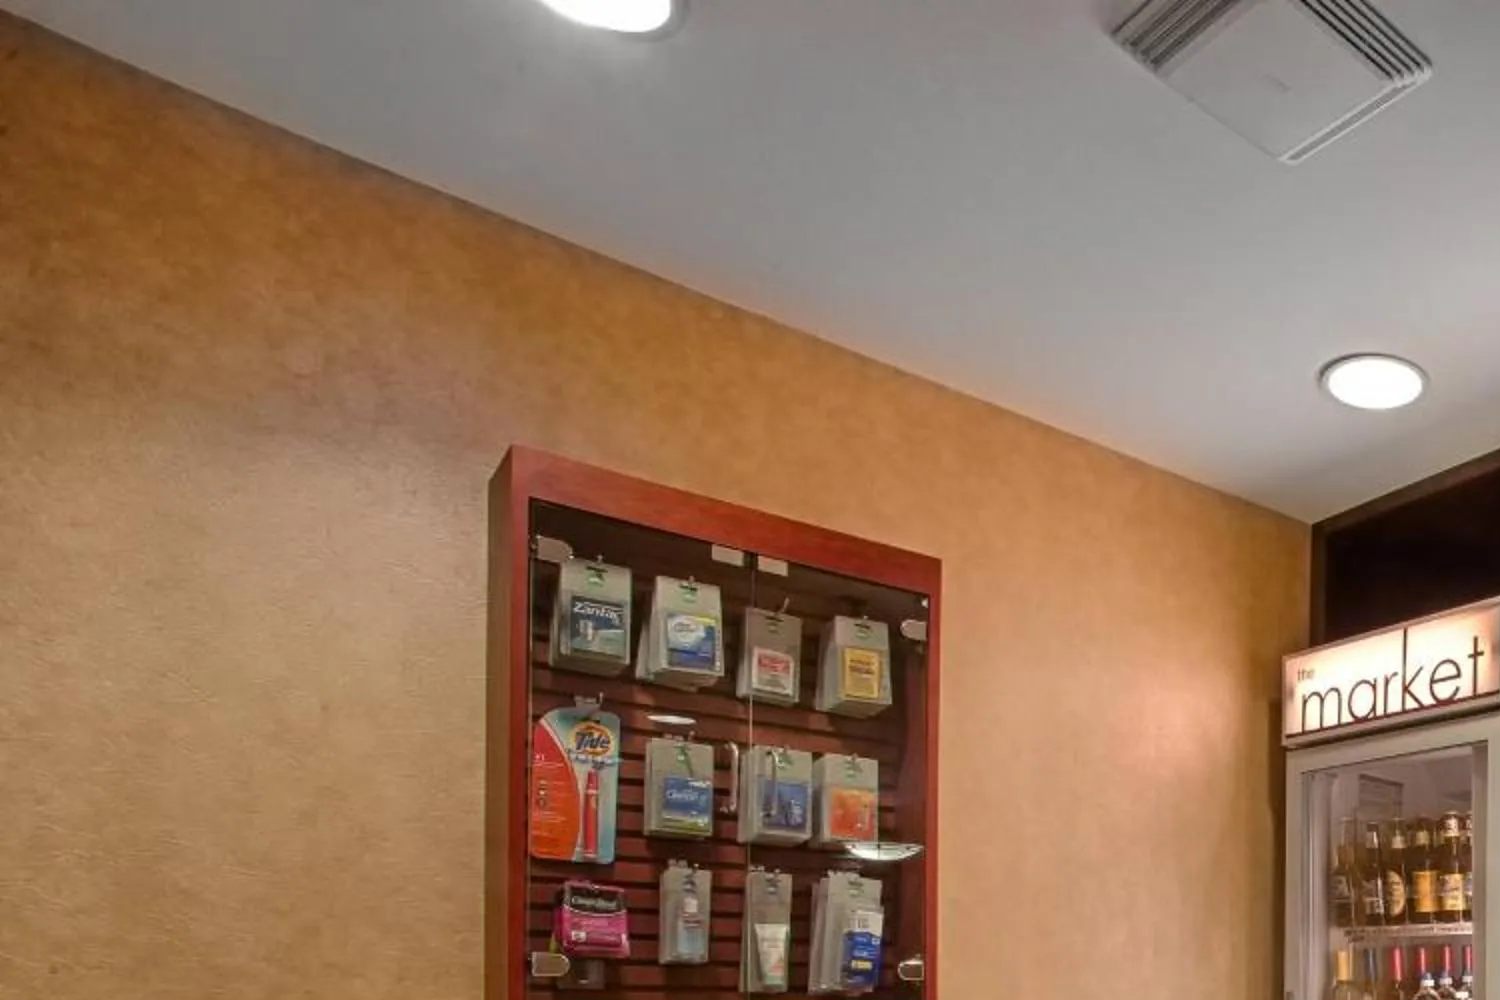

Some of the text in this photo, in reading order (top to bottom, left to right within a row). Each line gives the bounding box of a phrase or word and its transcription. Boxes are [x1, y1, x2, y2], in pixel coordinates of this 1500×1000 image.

[1297, 667, 1315, 683] the
[1301, 629, 1484, 732] market
[575, 731, 611, 750] Tide
